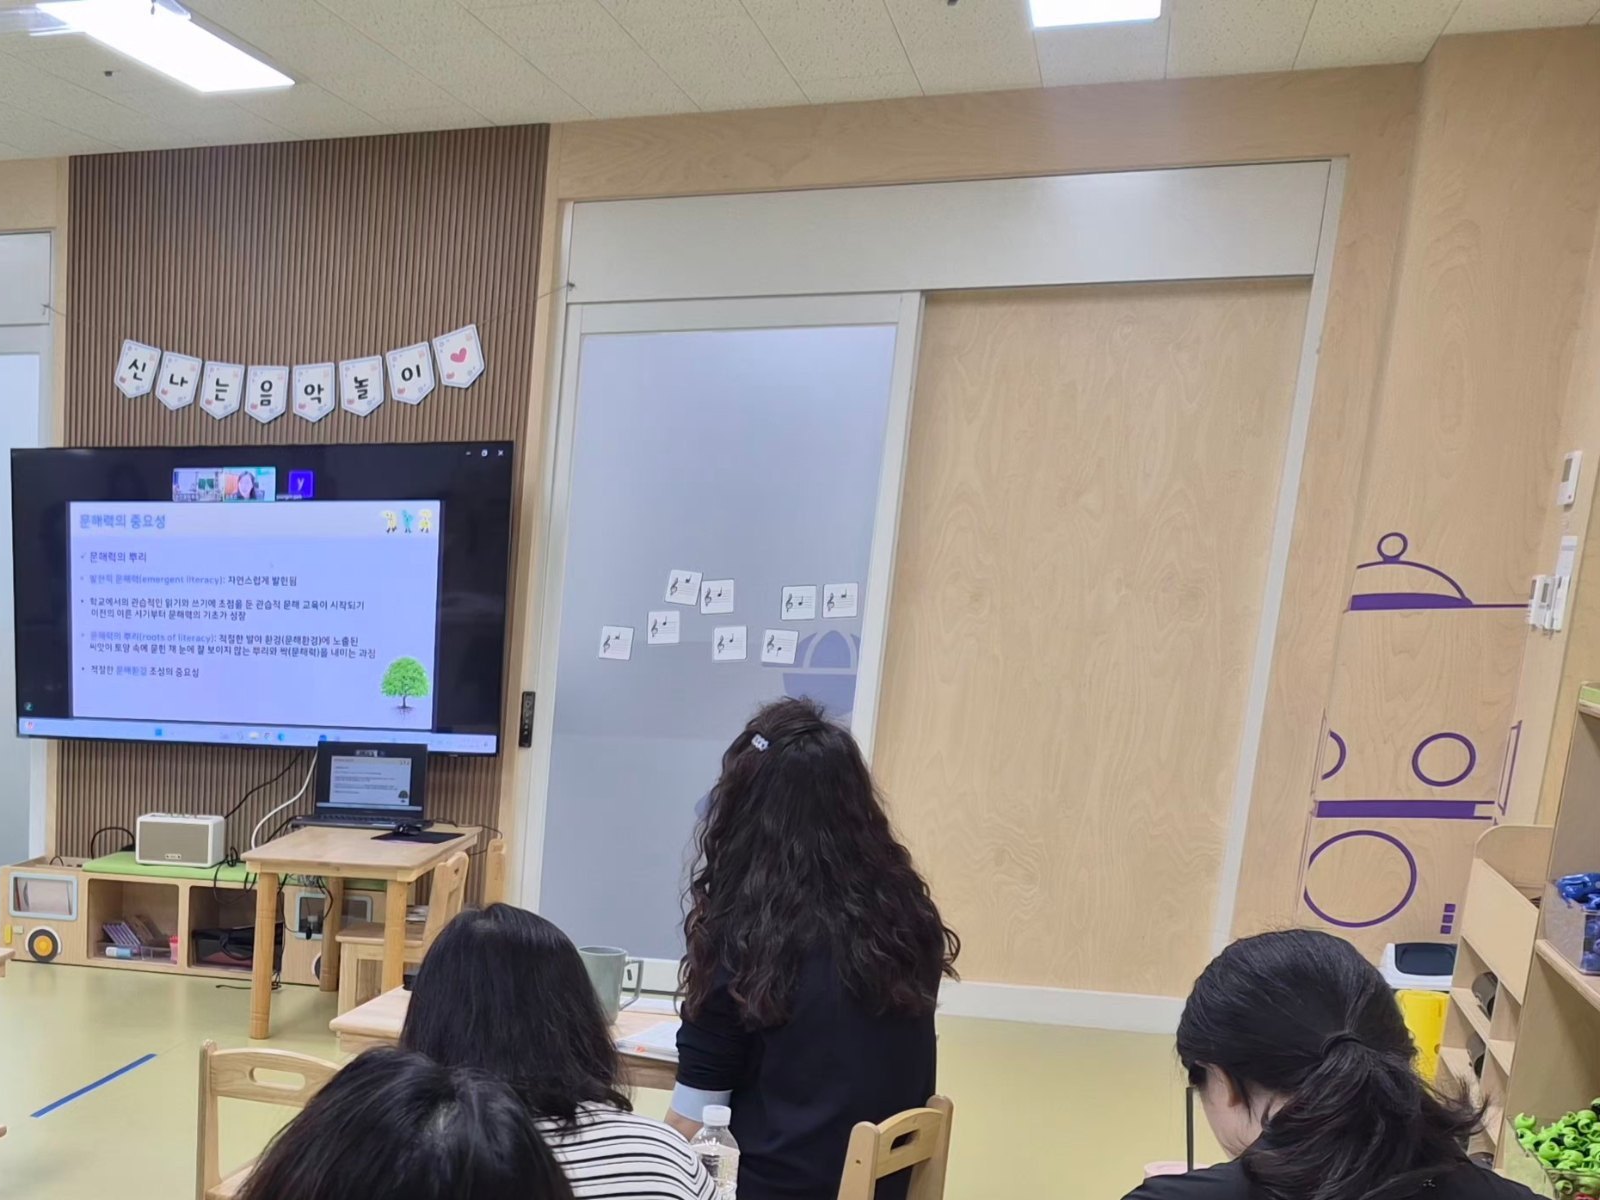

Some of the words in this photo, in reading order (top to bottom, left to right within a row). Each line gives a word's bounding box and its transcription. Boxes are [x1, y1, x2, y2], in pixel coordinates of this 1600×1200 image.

[128, 358, 231, 402] 신나는
[259, 379, 325, 407] 음악
[353, 365, 422, 401] 놀이
